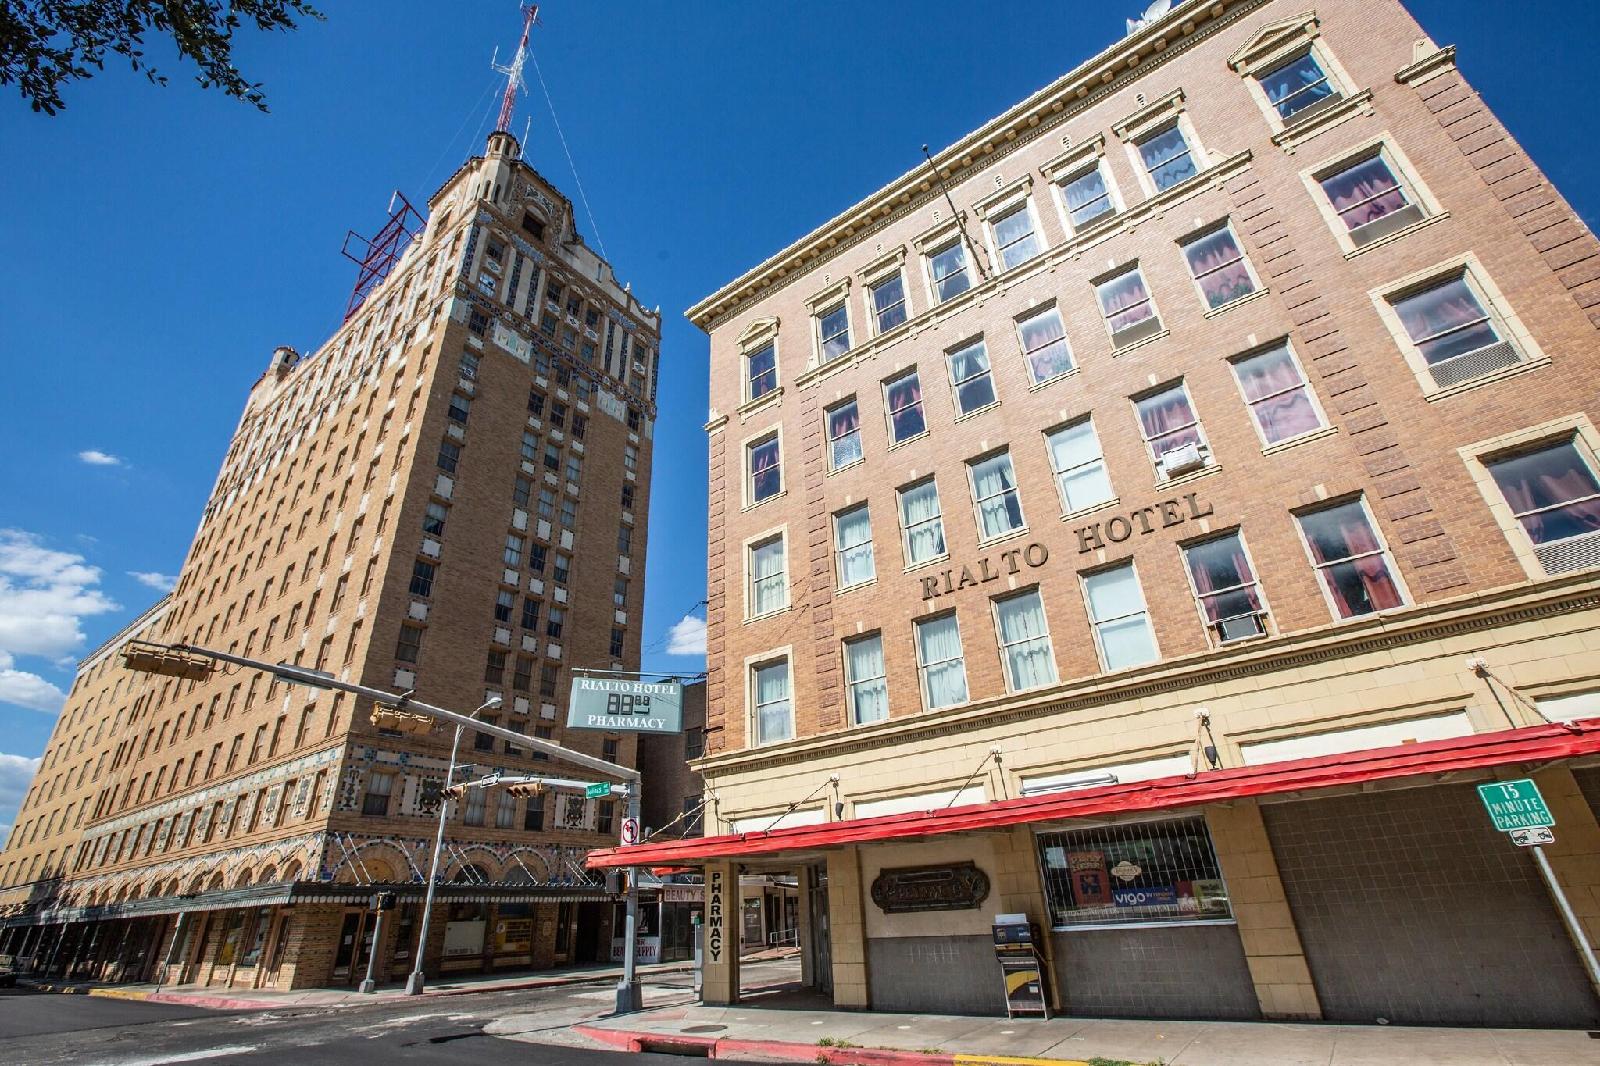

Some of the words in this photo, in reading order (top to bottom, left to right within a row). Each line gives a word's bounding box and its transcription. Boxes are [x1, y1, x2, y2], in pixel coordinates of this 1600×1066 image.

[919, 543, 1049, 600] RIALTO
[1073, 492, 1214, 554] HOTEL
[580, 679, 630, 692] RIALTO
[632, 683, 677, 695] HOTEL
[587, 714, 666, 729] PHARMACY
[1500, 784, 1520, 799] 15
[1491, 797, 1542, 815] MINUTE
[1496, 811, 1550, 828] PARKING
[665, 888, 697, 900] BEAUTY
[1115, 892, 1146, 905] vigo
[709, 872, 723, 962] PHARMACY
